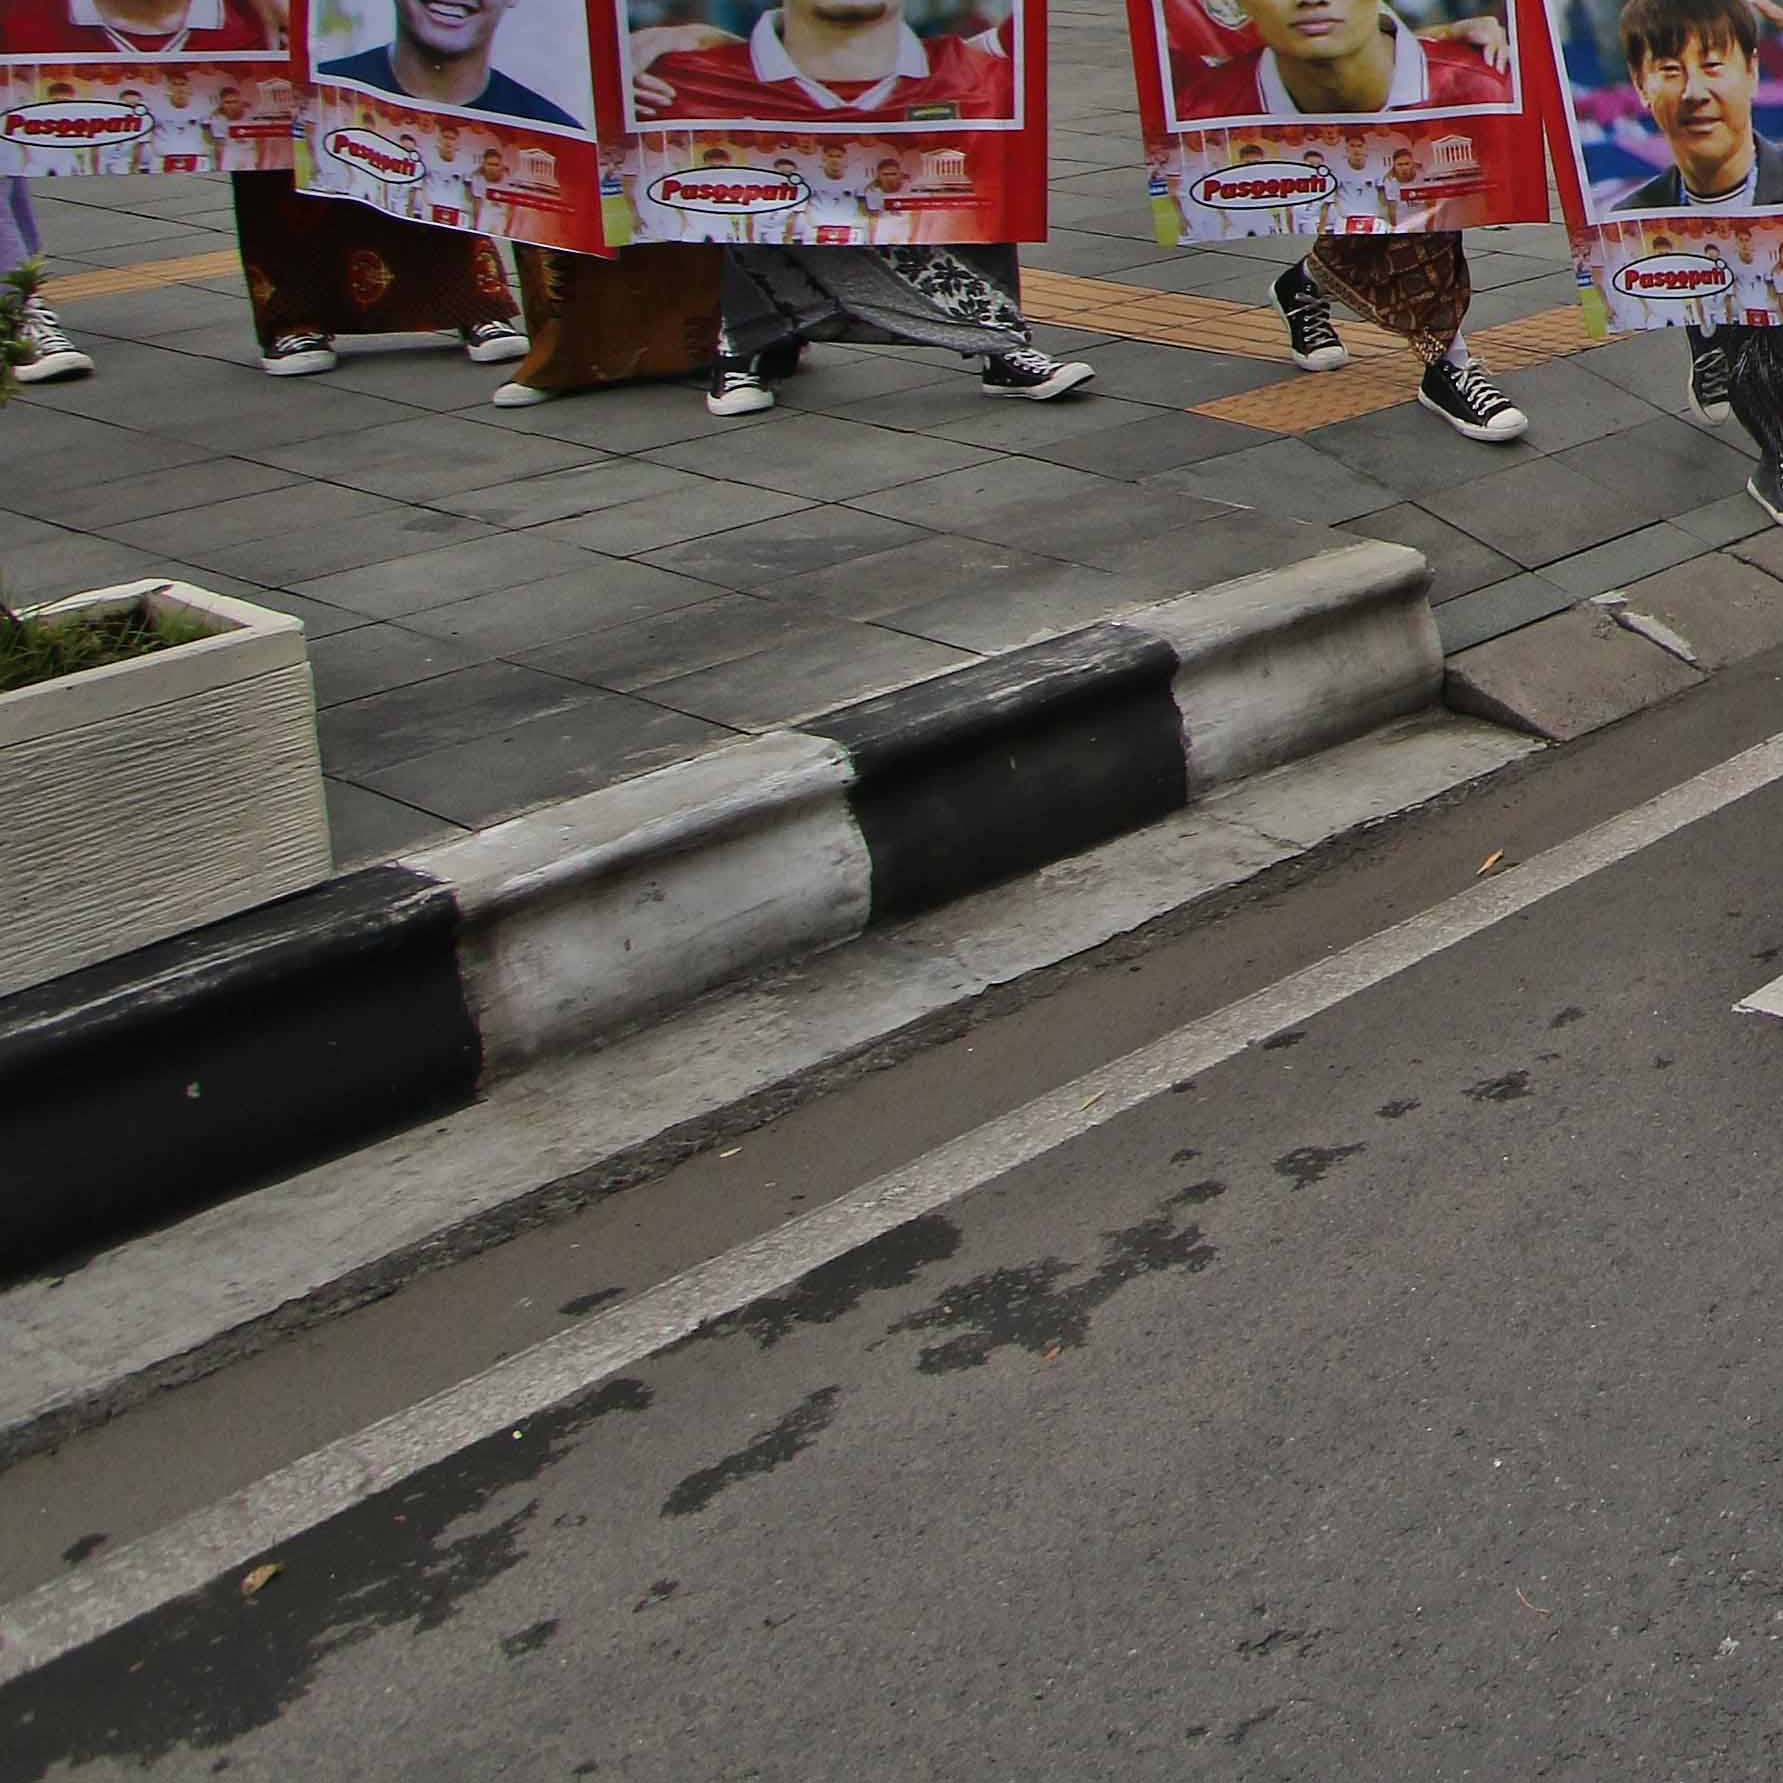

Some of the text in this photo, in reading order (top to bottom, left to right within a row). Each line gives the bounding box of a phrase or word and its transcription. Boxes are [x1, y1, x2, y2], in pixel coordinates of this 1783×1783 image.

[661, 178, 799, 206] Pasoepati
[1203, 174, 1327, 202] Pasoepati
[1624, 267, 1728, 291] Pasoepati
